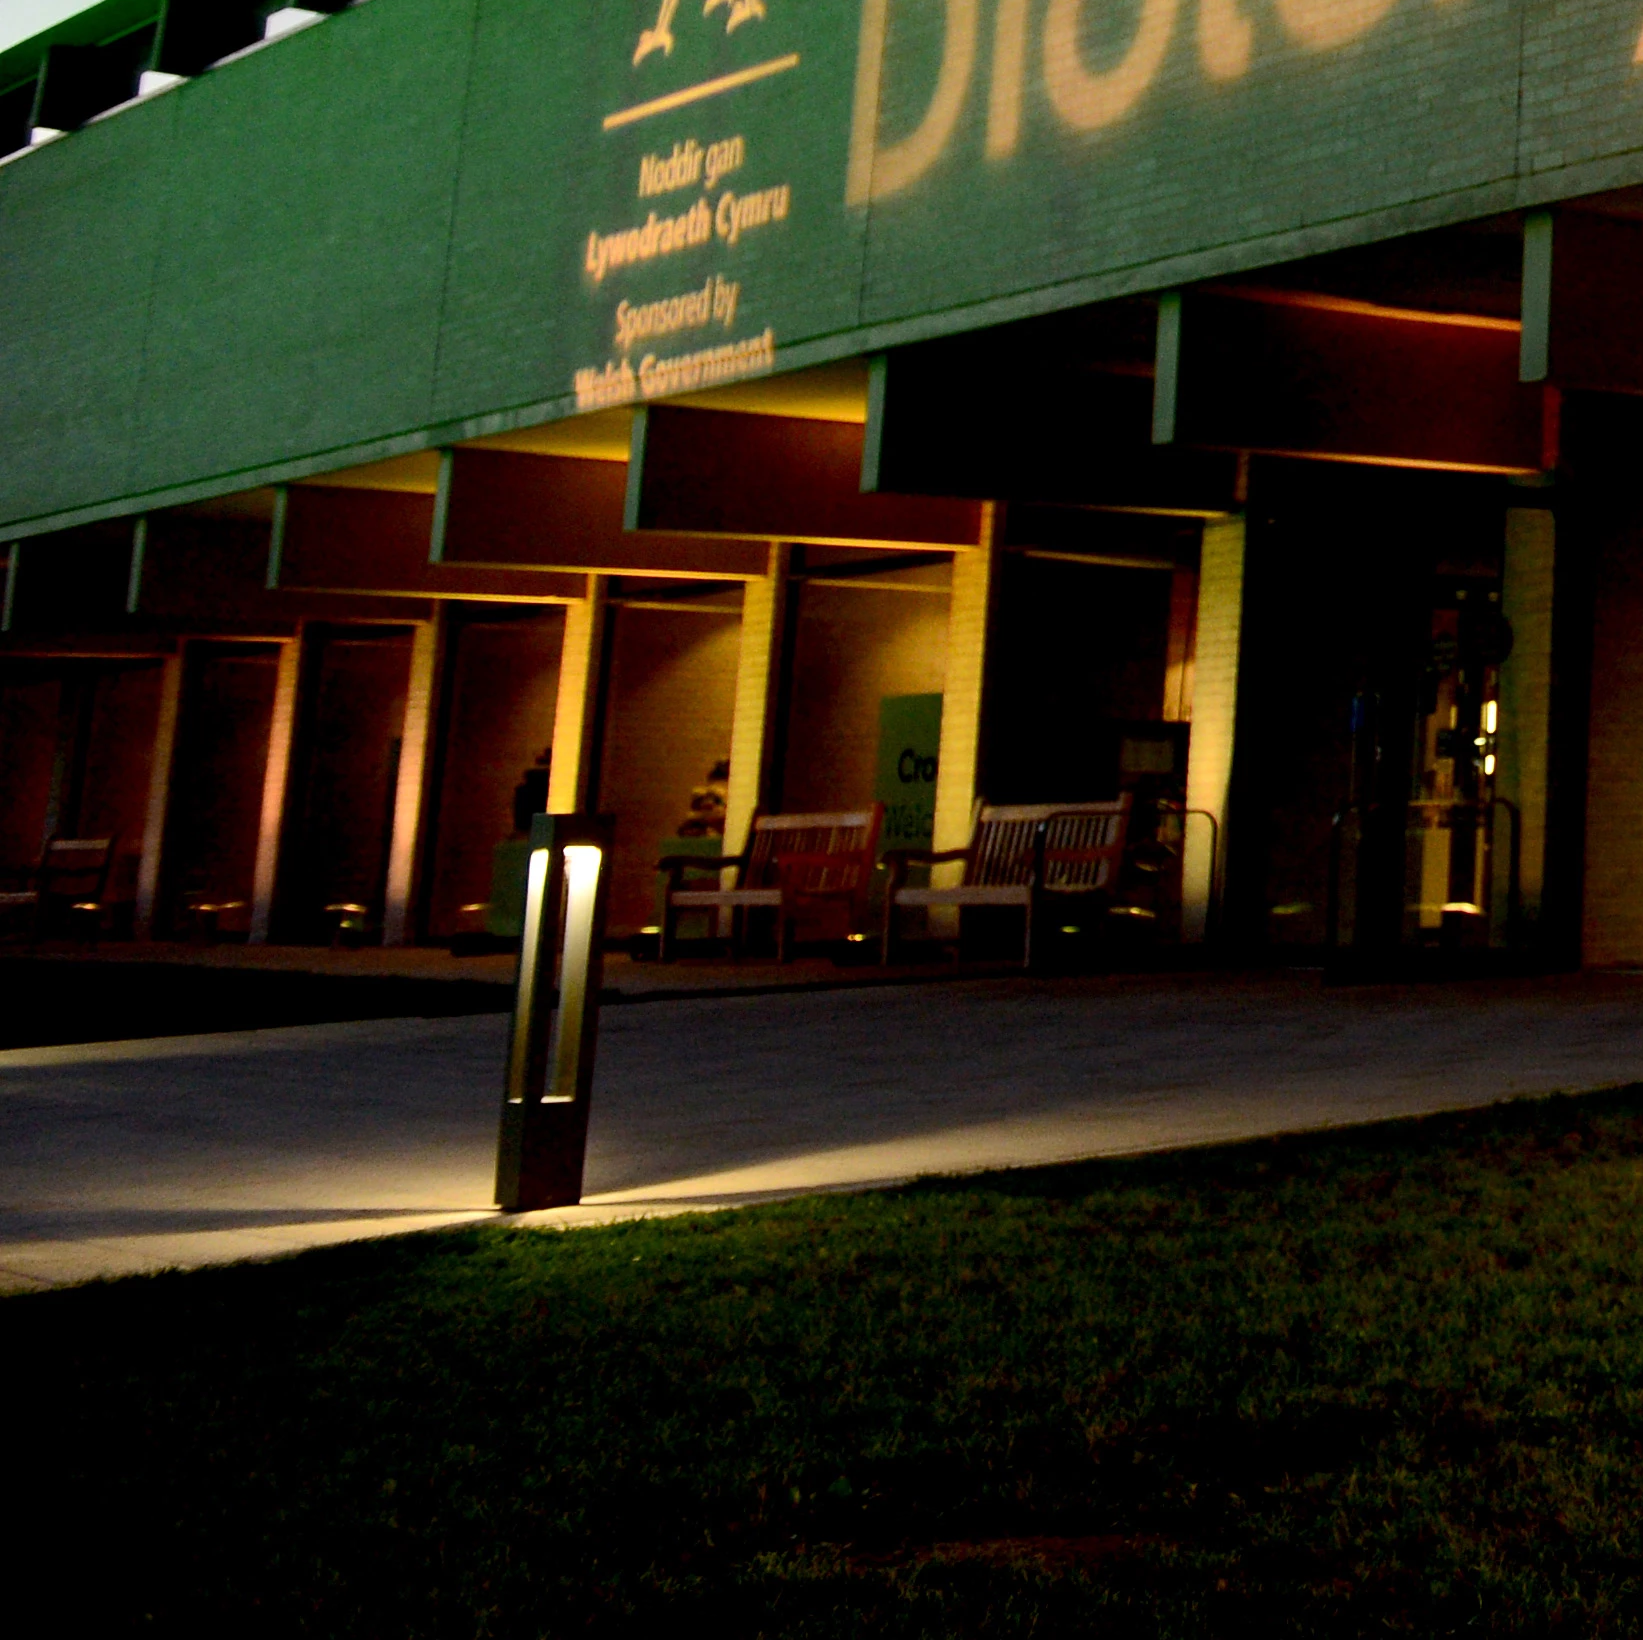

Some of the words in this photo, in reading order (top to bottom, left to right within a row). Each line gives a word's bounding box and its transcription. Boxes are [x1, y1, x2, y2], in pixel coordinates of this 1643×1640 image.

[638, 138, 703, 198] Noddir
[705, 134, 745, 191] gan
[585, 197, 712, 282] Lywodraeth
[715, 183, 791, 246] Cymru
[615, 276, 712, 350] Sponsored
[713, 272, 740, 328] by
[639, 326, 774, 397] Government
